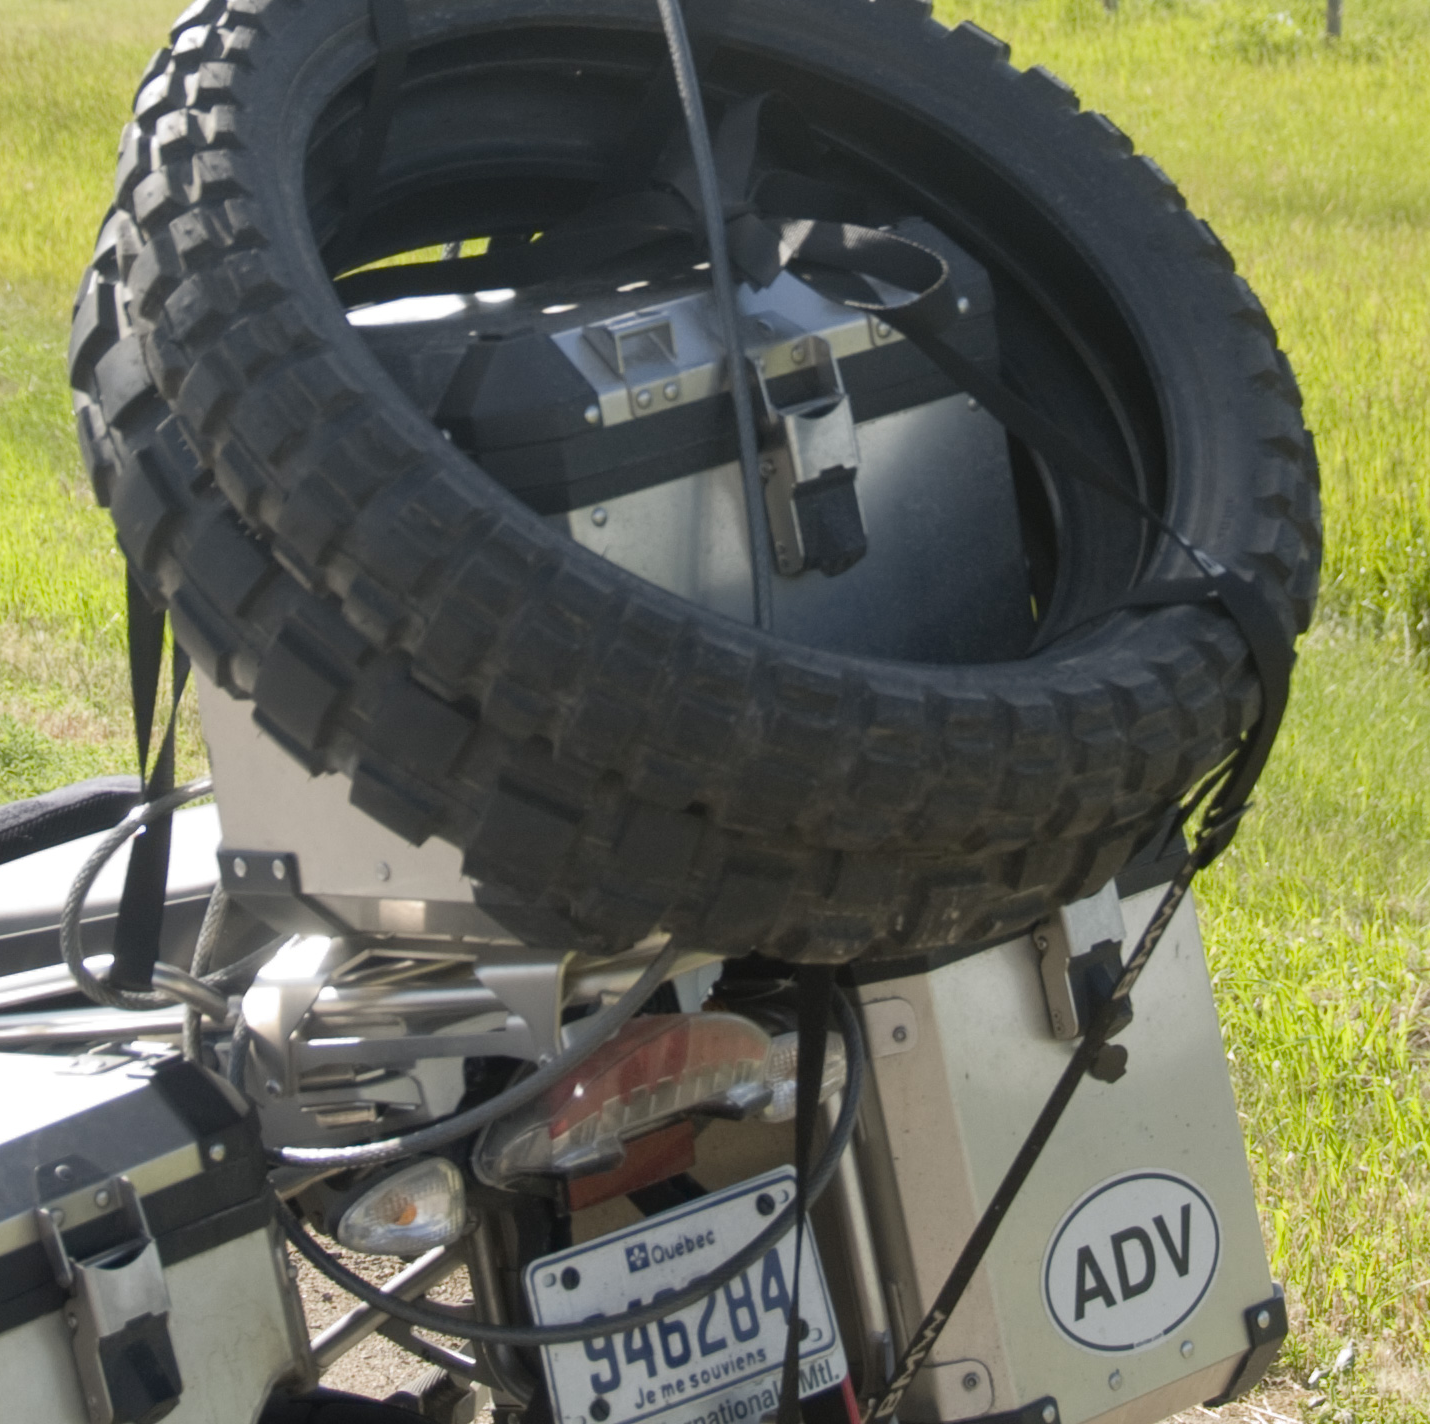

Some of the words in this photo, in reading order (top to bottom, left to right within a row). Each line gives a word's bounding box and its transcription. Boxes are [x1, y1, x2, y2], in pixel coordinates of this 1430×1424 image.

[651, 1229, 715, 1264] Québec
[1074, 1202, 1192, 1323] ADV
[583, 1247, 794, 1395] 946284
[635, 1387, 657, 1409] Je
[661, 1377, 686, 1400] me
[690, 1347, 767, 1388] souviens
